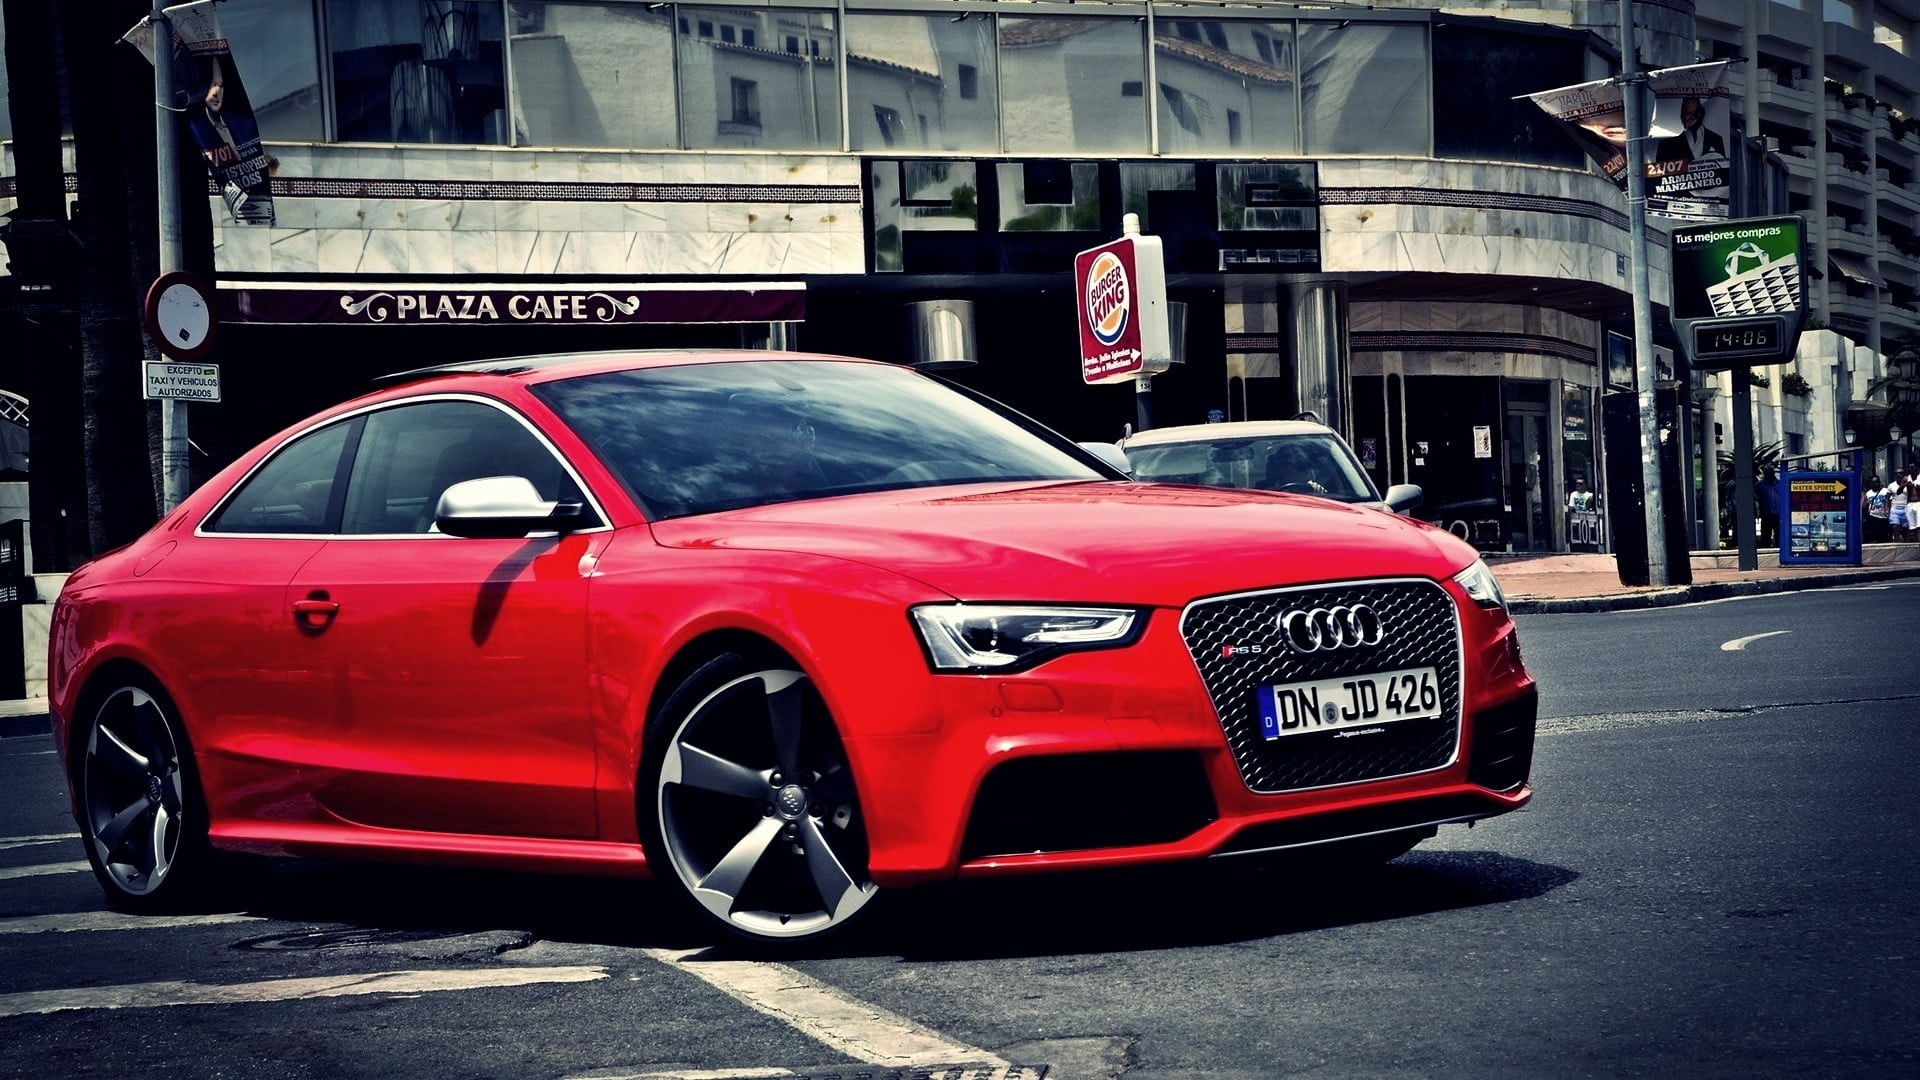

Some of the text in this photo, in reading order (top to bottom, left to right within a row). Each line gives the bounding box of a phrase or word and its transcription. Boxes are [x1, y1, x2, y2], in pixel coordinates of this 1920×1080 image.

[1648, 161, 1683, 175] 21/07
[1655, 177, 1722, 193] MANZANERO
[1661, 170, 1715, 185] ARMANDO
[1675, 226, 1781, 244] Tus mejores compras
[1090, 265, 1122, 306] BURGER
[397, 295, 588, 319] PLAZA CAFE
[1093, 281, 1125, 329] KING
[1715, 329, 1767, 348] 14:06
[167, 366, 202, 376] EXCEPTO
[150, 376, 218, 387] TAXI Y VEHICULOS
[158, 388, 212, 398] AUTORIZADOS
[1251, 644, 1262, 654] 5
[1277, 672, 1438, 730] DN JD 426
[1265, 716, 1273, 729] D
